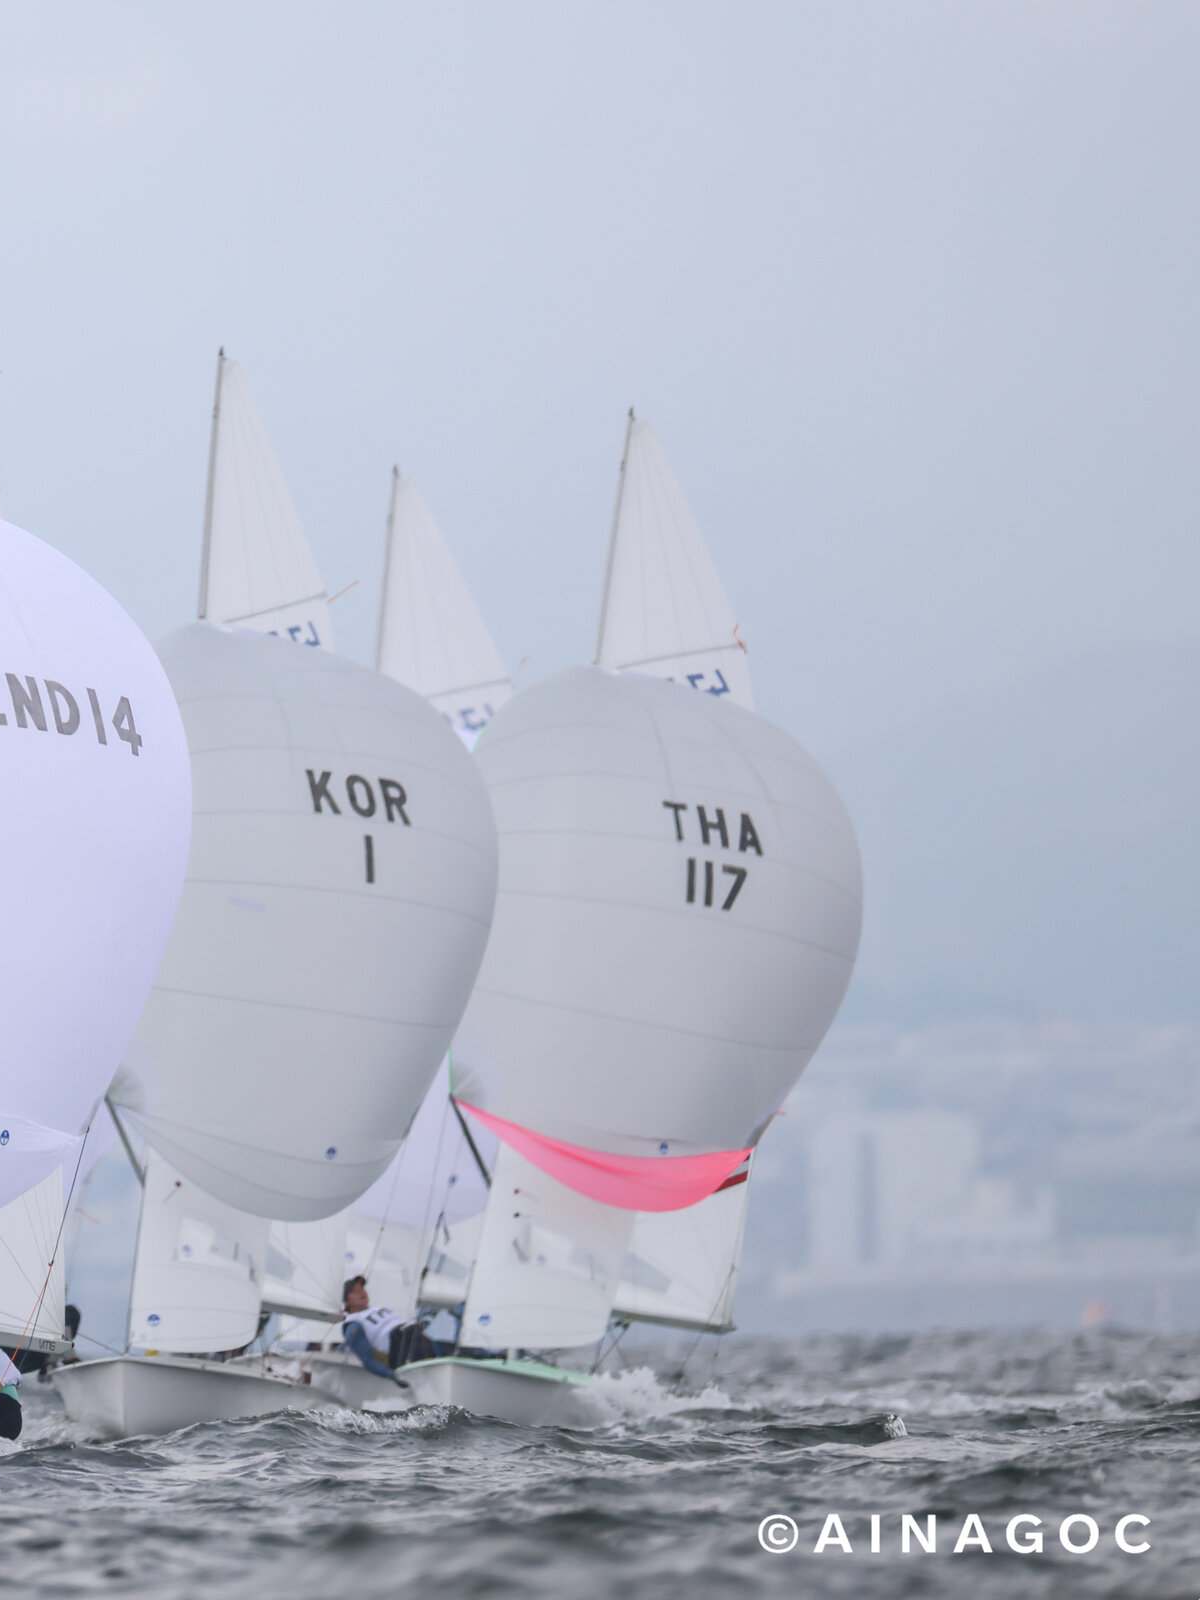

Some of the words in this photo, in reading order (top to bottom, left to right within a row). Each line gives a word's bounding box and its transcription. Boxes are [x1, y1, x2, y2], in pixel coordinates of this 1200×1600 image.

[305, 768, 412, 827] KOR
[662, 800, 763, 857] THA
[364, 834, 375, 884] 1
[686, 857, 748, 911] 117
